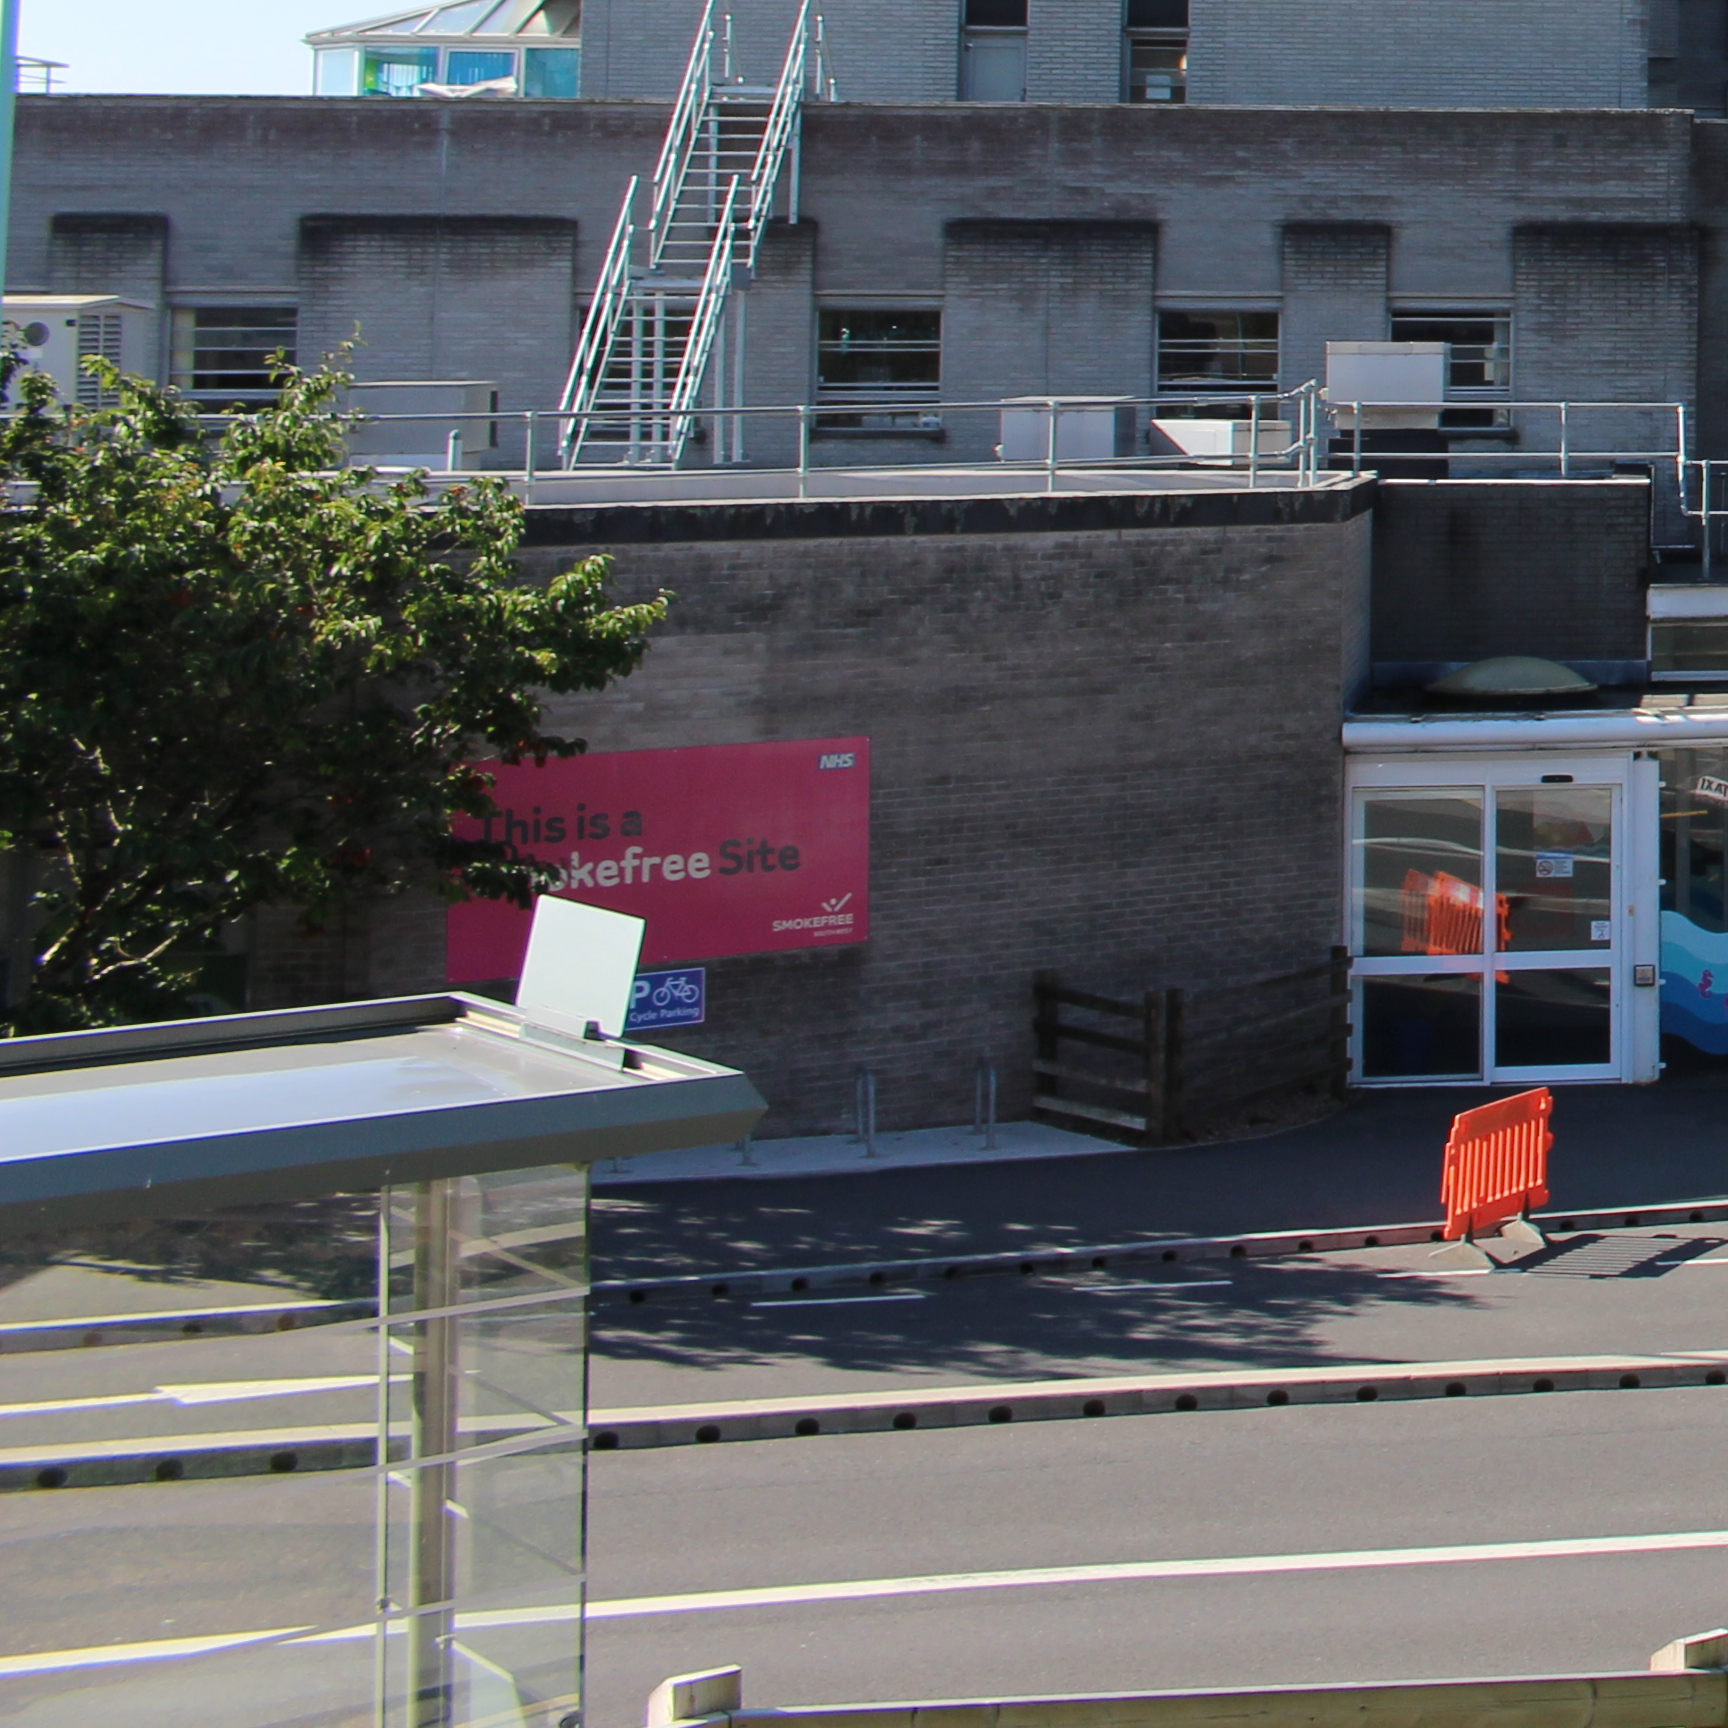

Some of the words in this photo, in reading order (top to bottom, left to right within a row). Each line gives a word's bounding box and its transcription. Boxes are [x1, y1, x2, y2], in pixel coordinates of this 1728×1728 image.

[820, 754, 854, 769] NHS
[484, 808, 566, 846] This
[577, 804, 611, 840] is
[620, 810, 643, 836] a
[718, 838, 801, 874] Site
[772, 913, 854, 932] SMOKEFREE
[630, 980, 651, 1009] P
[629, 1011, 658, 1024] Cycle
[660, 1007, 700, 1019] Parking
